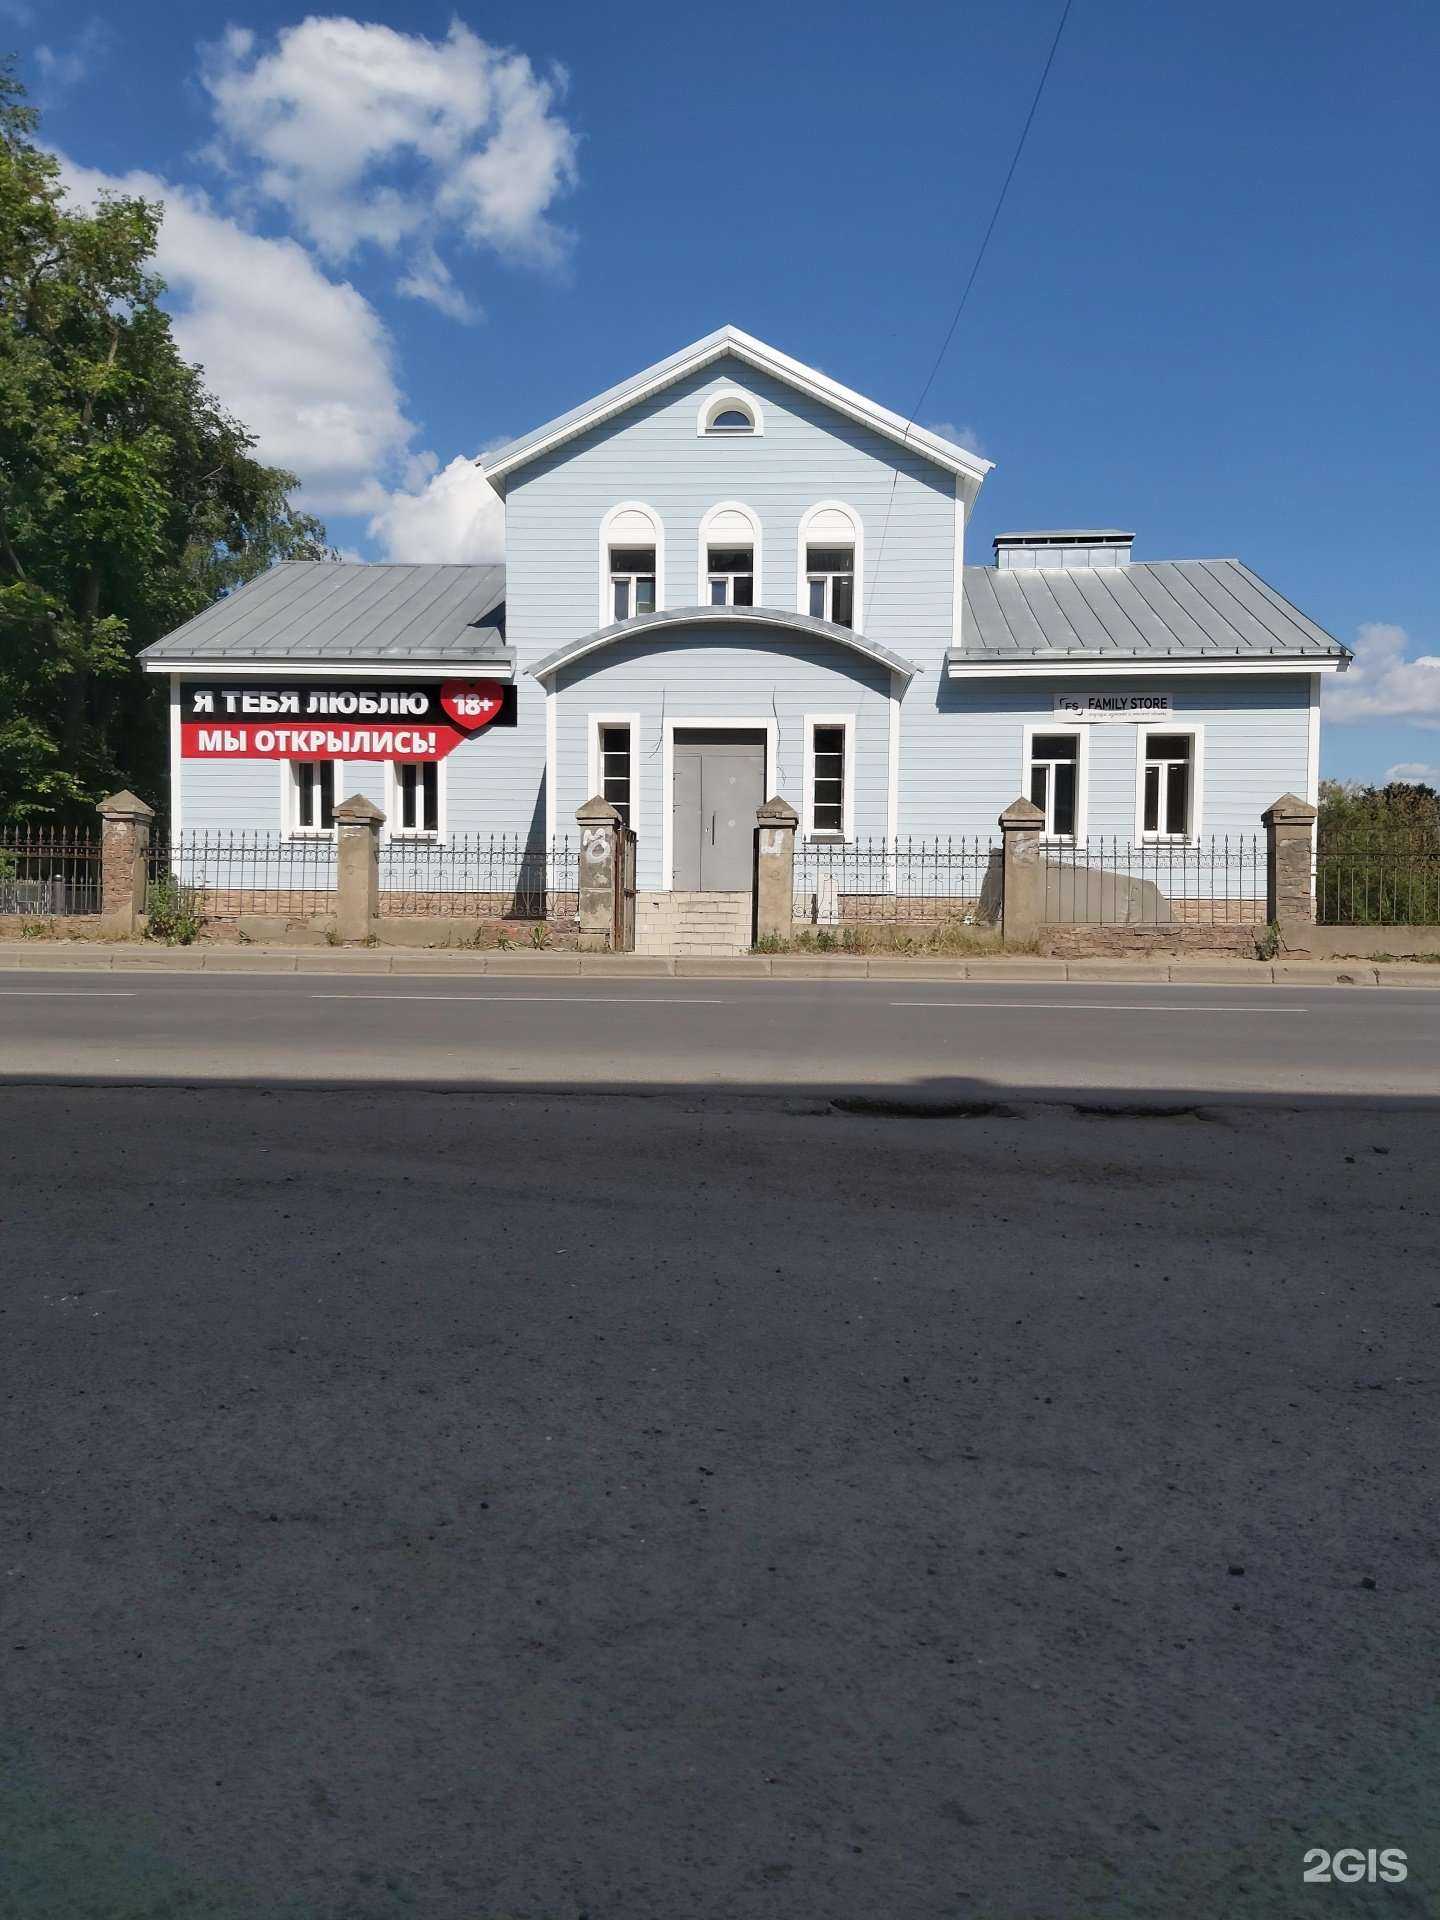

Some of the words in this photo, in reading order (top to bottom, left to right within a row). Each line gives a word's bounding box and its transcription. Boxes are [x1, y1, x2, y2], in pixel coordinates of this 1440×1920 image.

[192, 690, 214, 714] Я
[221, 690, 300, 715] ТЕБЯ
[306, 691, 429, 715] ЛЮБЛЮ
[452, 694, 493, 716] 18+
[1088, 697, 1127, 710] FAMILY
[1131, 697, 1168, 709] STORE
[198, 730, 248, 753] МЫ
[254, 729, 437, 754] ОТКРЫЛИСЬ!
